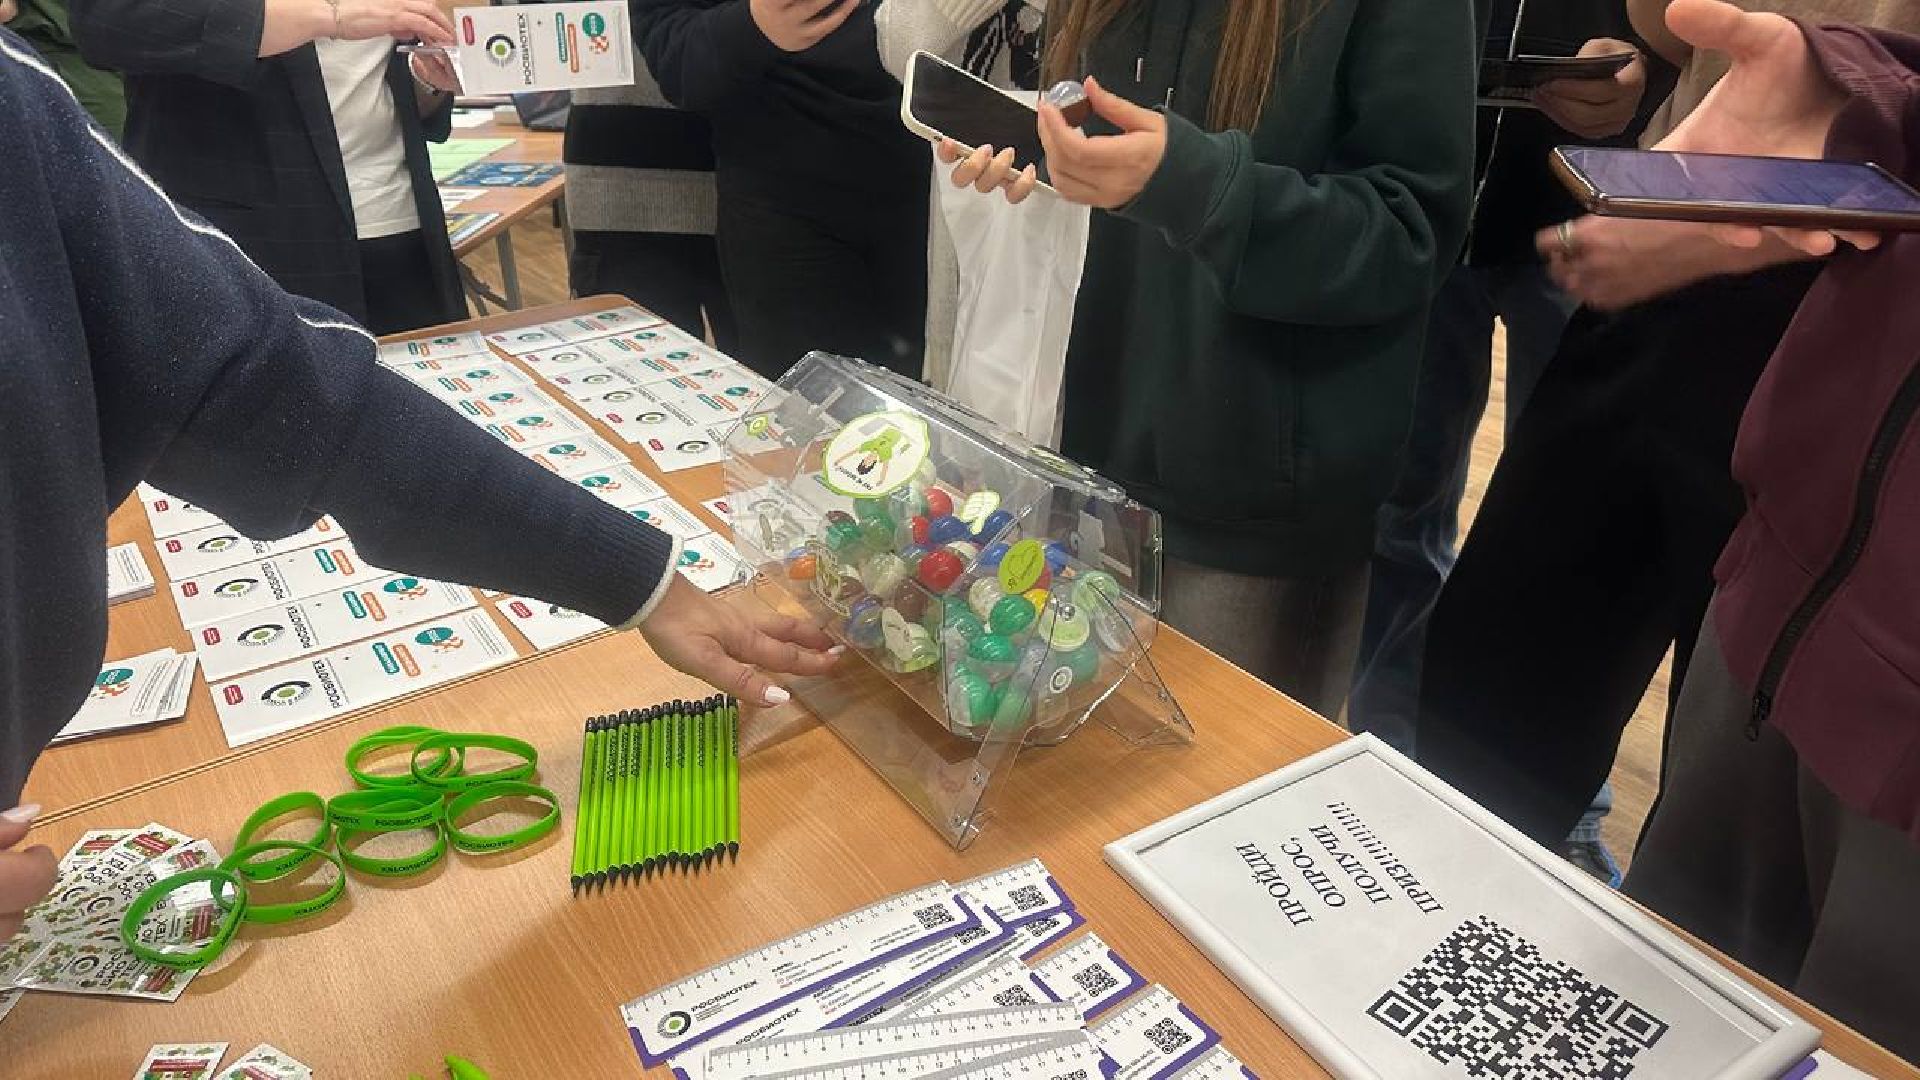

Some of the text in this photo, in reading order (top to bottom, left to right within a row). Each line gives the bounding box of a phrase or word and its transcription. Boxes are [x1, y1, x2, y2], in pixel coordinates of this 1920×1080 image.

[1235, 843, 1314, 926] ПРОЙДИ
[1280, 837, 1346, 907] ОПРОС,
[1308, 824, 1393, 904] ПОЛУЧИ
